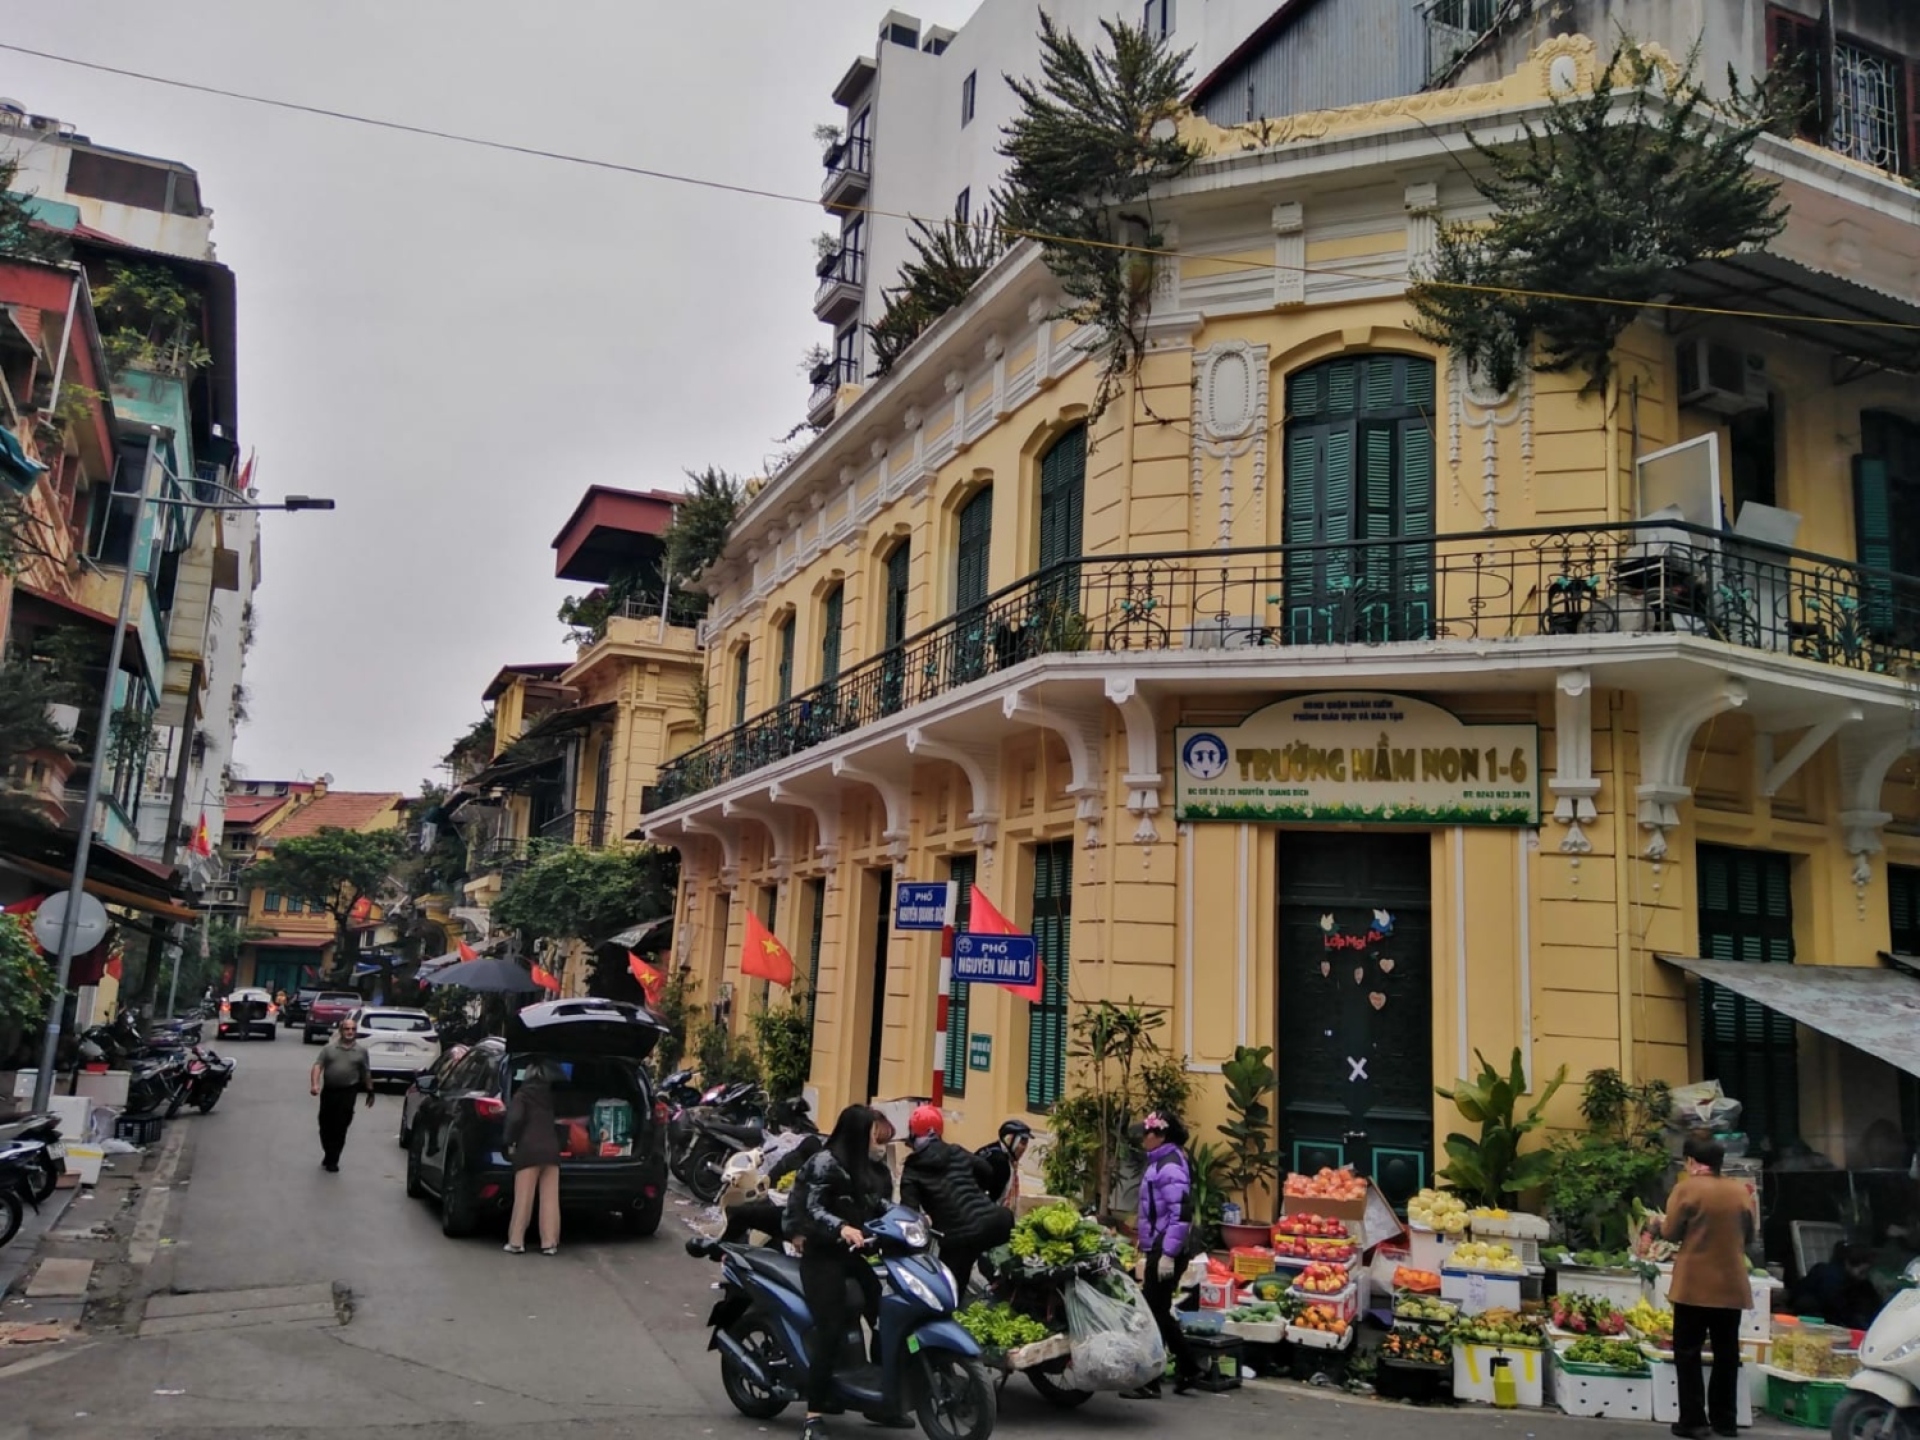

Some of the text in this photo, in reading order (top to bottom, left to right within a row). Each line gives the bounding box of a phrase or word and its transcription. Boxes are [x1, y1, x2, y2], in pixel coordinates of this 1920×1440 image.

[1236, 739, 1346, 782] TRƯỜNG
[1351, 731, 1416, 782] MẦM
[1421, 747, 1479, 783] NON
[1485, 746, 1527, 783] 1-6
[915, 889, 934, 901] PHỐ
[981, 941, 1008, 953] PHỐ
[958, 952, 1031, 978] NGUYỄN VĂN TỐ
